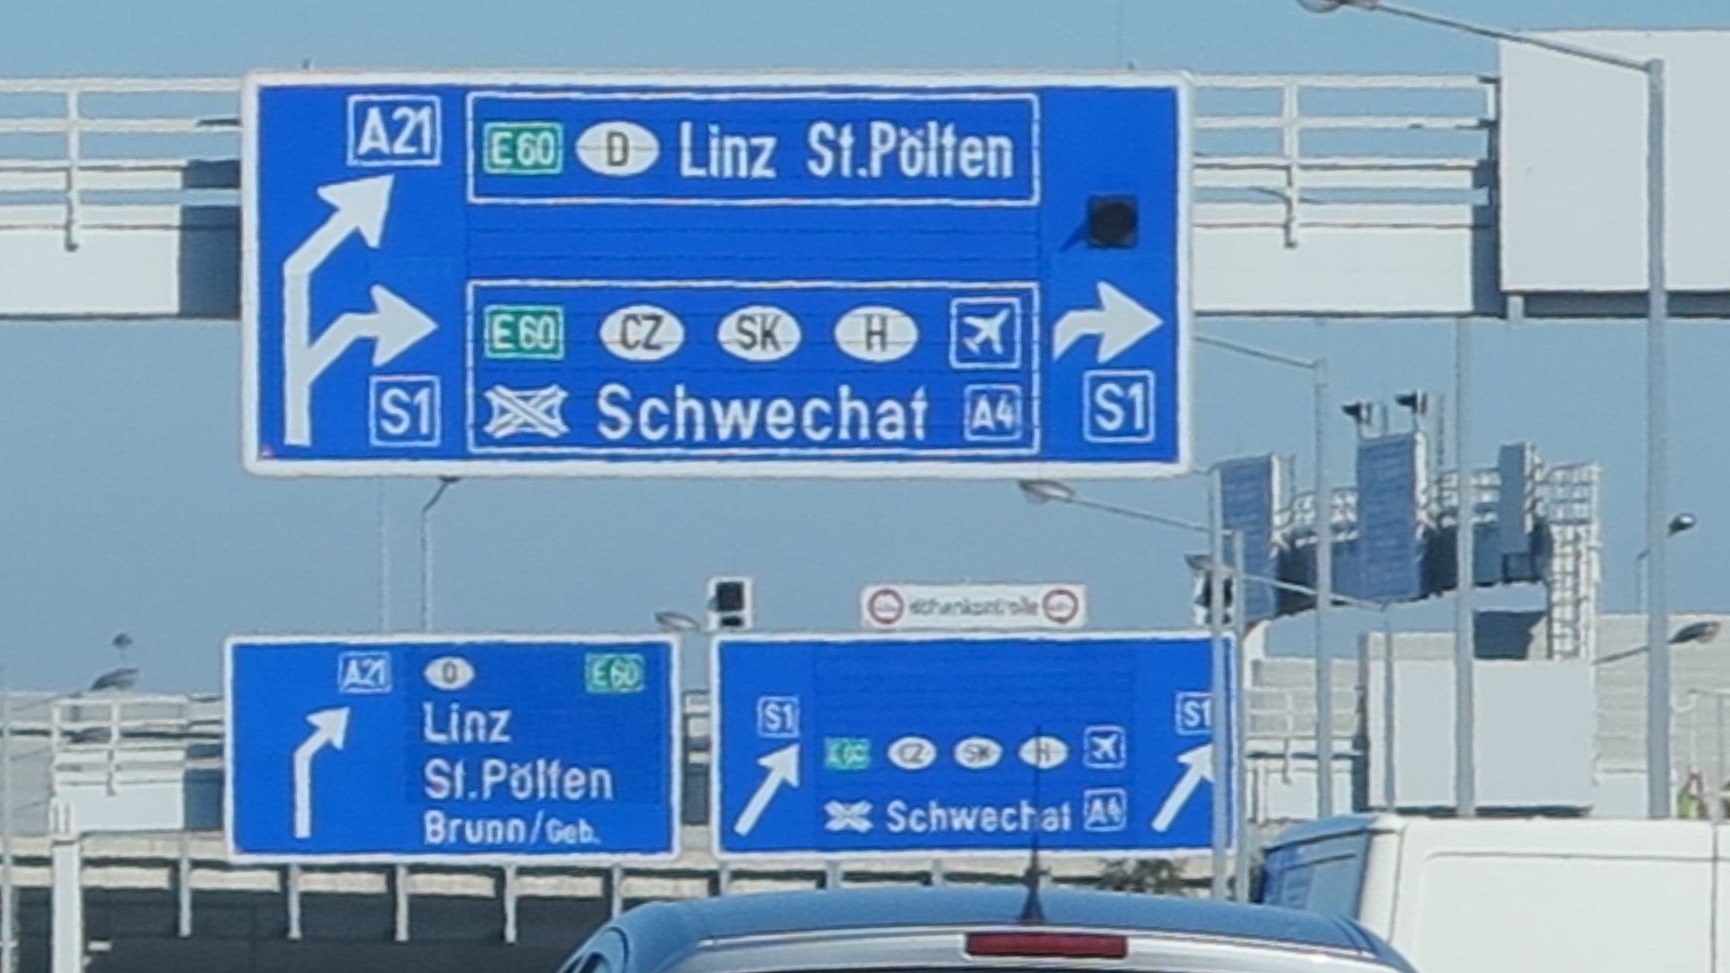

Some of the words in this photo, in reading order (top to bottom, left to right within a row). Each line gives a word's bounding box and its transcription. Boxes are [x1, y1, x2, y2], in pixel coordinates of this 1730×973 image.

[358, 106, 431, 155] A21
[491, 132, 555, 164] E60
[607, 132, 628, 166] D
[680, 121, 777, 178] Linz
[807, 120, 1014, 178] St.Pölten
[493, 315, 555, 350] E60
[620, 313, 664, 351] CZ
[736, 314, 782, 352] SK
[866, 315, 887, 352] H
[381, 387, 430, 435] S1
[598, 383, 928, 440] Schwechat
[972, 398, 1014, 430] A4
[1095, 382, 1145, 431] S1
[344, 659, 387, 687] A21
[591, 659, 640, 687] E60
[423, 702, 511, 743] Linz
[764, 703, 794, 731] S1
[1181, 700, 1212, 729] S1
[898, 743, 926, 763] CZ
[964, 743, 989, 763] SK
[424, 759, 613, 800] St.Pölten
[886, 799, 1072, 832] Schwechat
